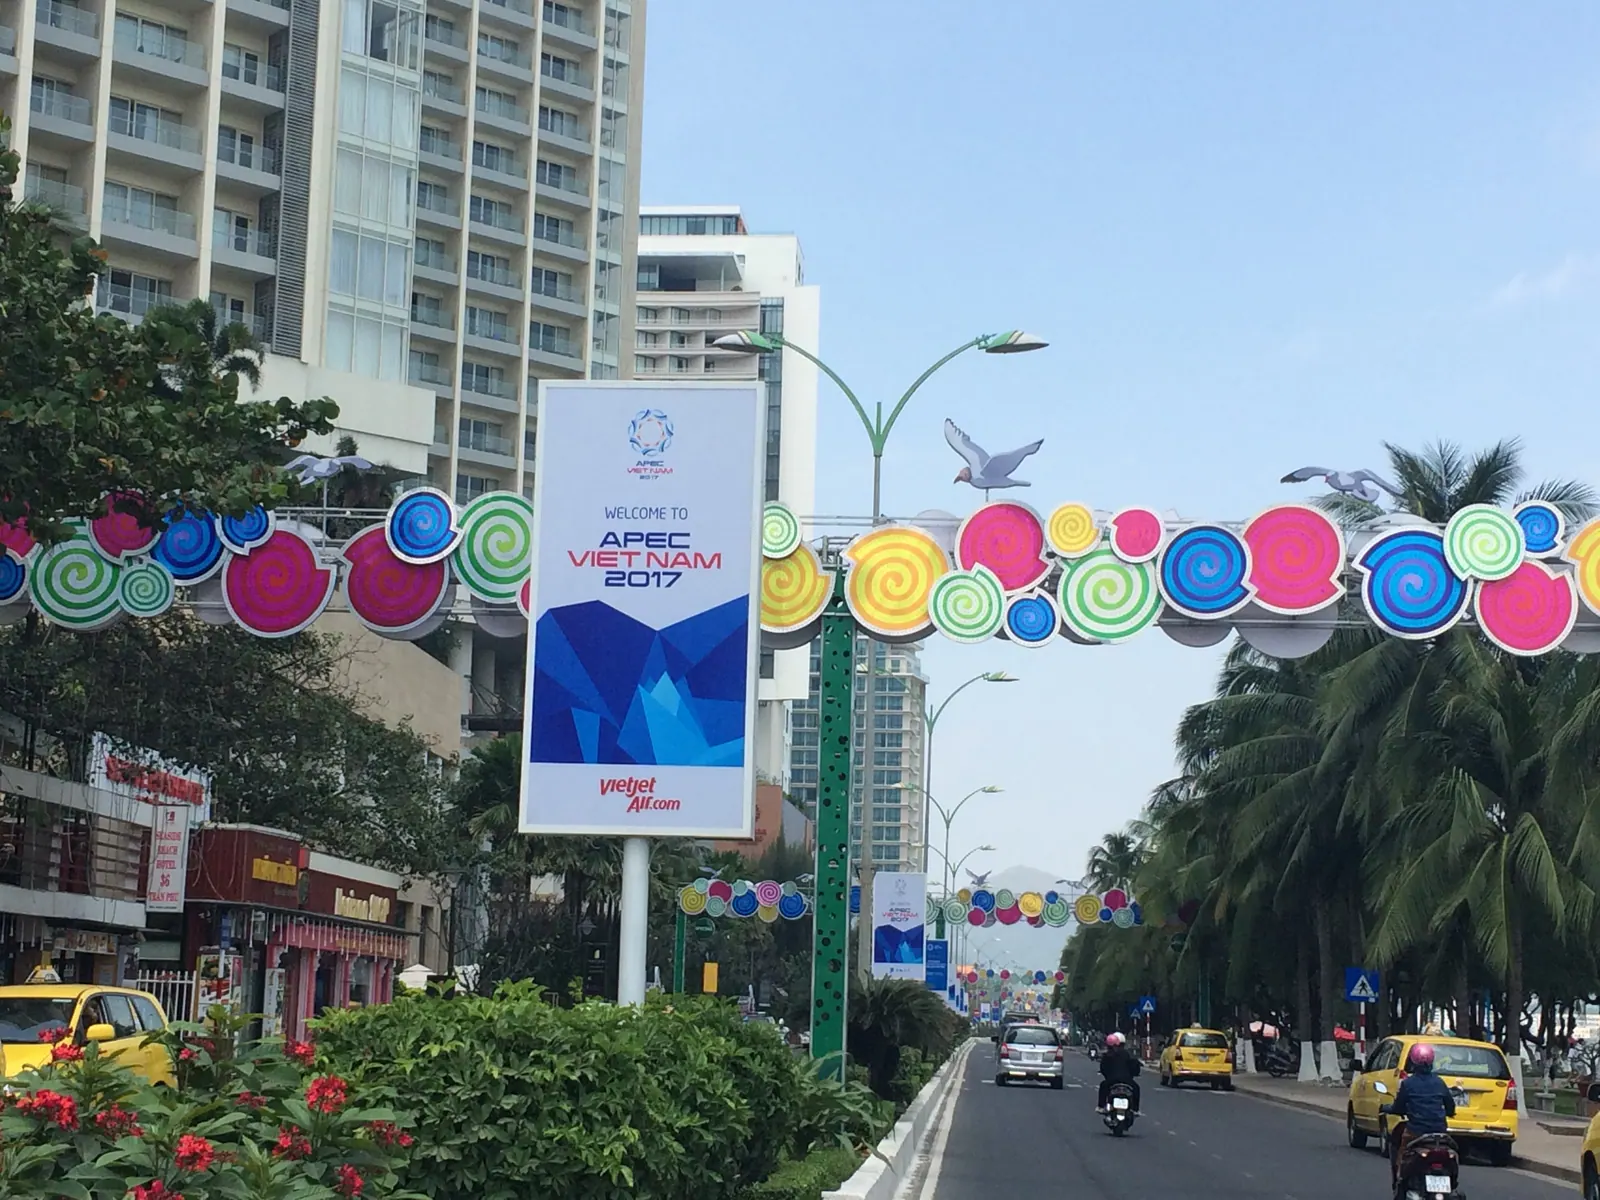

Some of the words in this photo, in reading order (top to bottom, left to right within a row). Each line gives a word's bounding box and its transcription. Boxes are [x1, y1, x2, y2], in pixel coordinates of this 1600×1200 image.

[604, 506, 667, 520] WELCOME
[671, 507, 688, 520] TO
[599, 531, 690, 549] APEC
[605, 571, 682, 588] 2017
